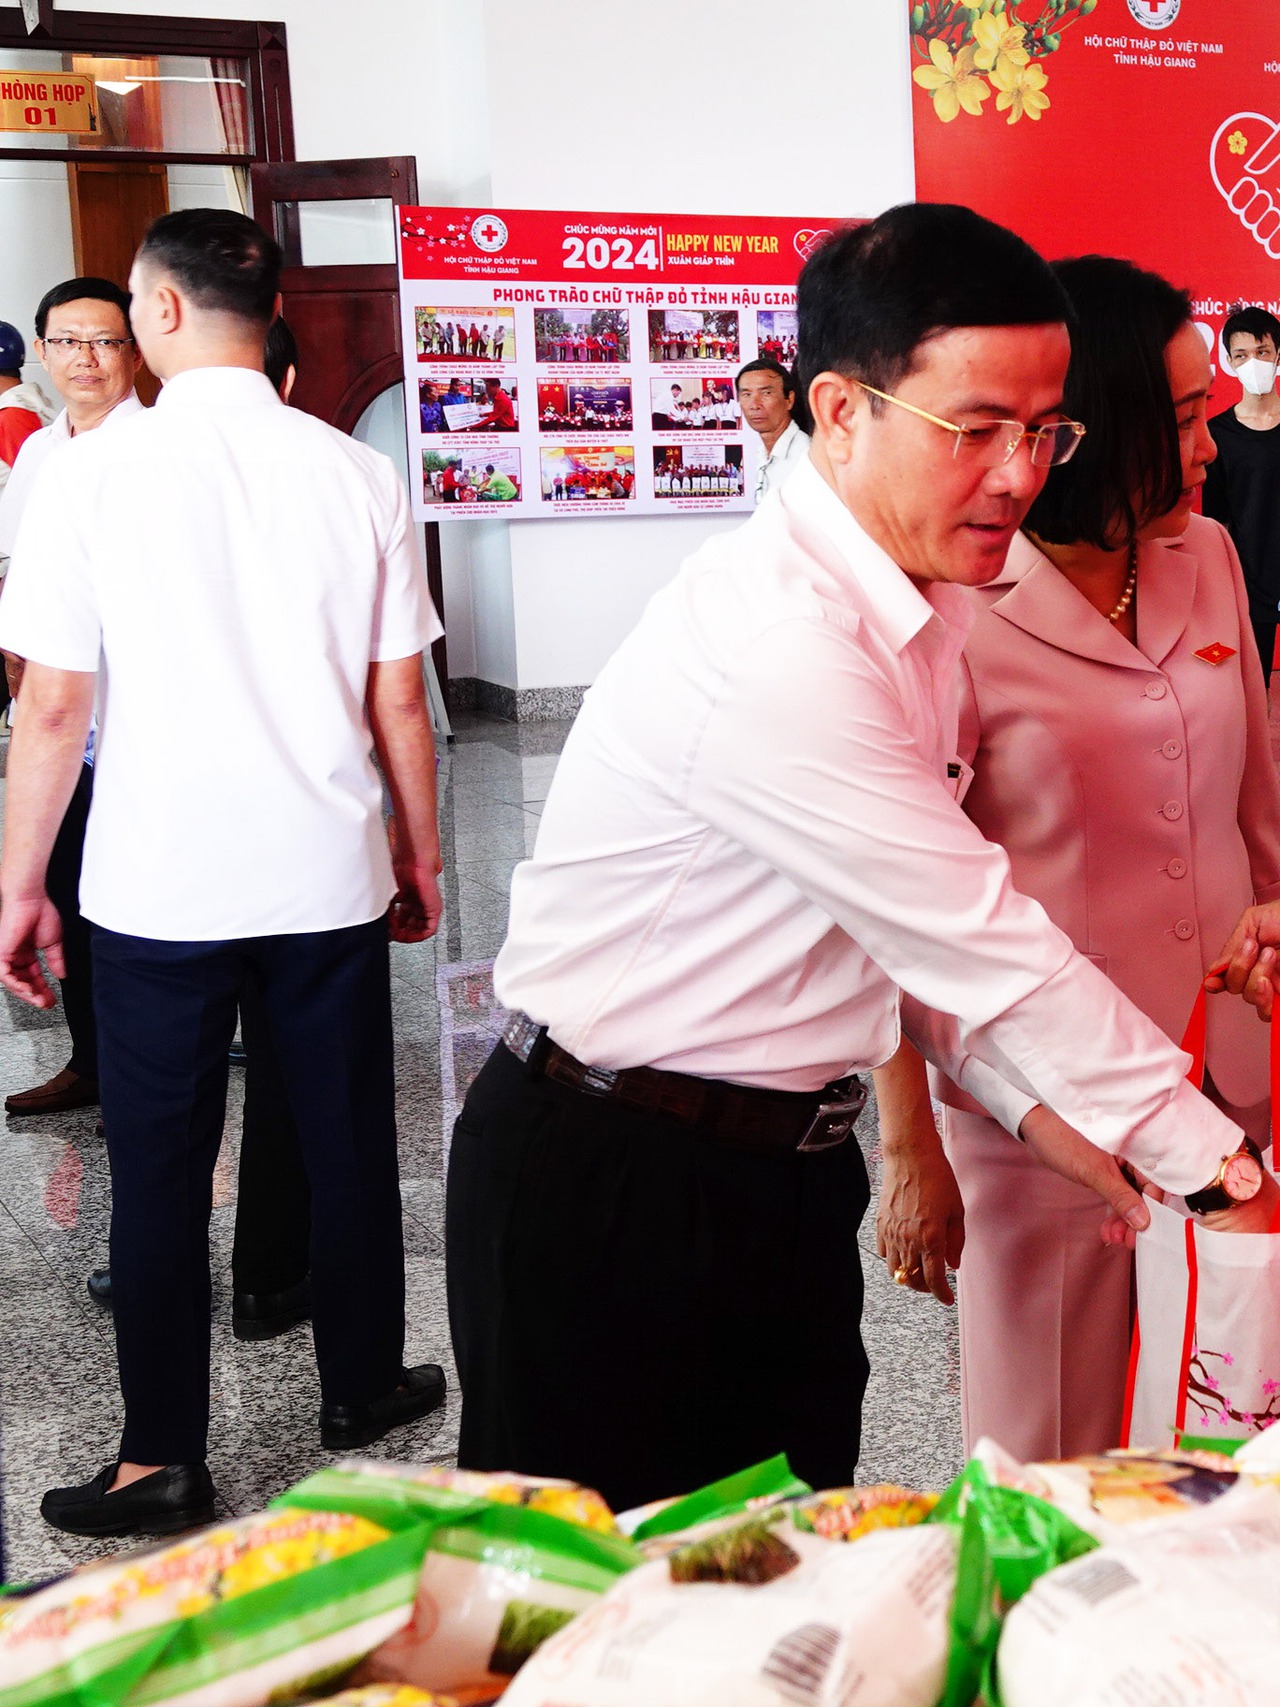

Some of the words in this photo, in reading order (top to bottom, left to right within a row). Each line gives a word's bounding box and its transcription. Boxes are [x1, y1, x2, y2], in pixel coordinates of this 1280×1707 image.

[1084, 34, 1103, 48] HỘI
[1105, 36, 1127, 48] CHỮ
[1129, 37, 1157, 51] THẬP
[1159, 38, 1175, 51] ĐỎ
[1176, 40, 1199, 54] VIỆT
[1201, 43, 1223, 54] NAM
[1113, 51, 1138, 65] TỈNH
[1140, 54, 1162, 68] HẬU
[1164, 57, 1197, 69] GIANG
[1263, 61, 1280, 74] HỘI
[0, 79, 48, 101] HÒNG
[52, 84, 85, 105] HỌP
[24, 106, 57, 126] 01
[564, 223, 589, 234] CHÚC
[591, 223, 618, 235] MỪNG
[619, 224, 639, 235] NĂM
[640, 225, 658, 236] MỚI
[561, 236, 659, 270] 2024
[666, 233, 709, 252] HAPPY
[713, 234, 743, 253] NEW
[746, 235, 779, 253] YEAR
[444, 255, 456, 264] HỘI
[474, 256, 493, 265] THẬP
[505, 257, 521, 266] VIỆT
[667, 254, 692, 265] XUÂN
[693, 255, 714, 265] GIÁP
[493, 288, 545, 302] PHONG
[548, 286, 589, 303] TRÀO
[592, 287, 622, 303] CHỮ
[626, 287, 664, 307] THẬP
[668, 287, 687, 304] ĐỎ
[691, 287, 727, 304] TỈNH
[731, 288, 760, 308] HẬU
[764, 292, 798, 305] GIAN
